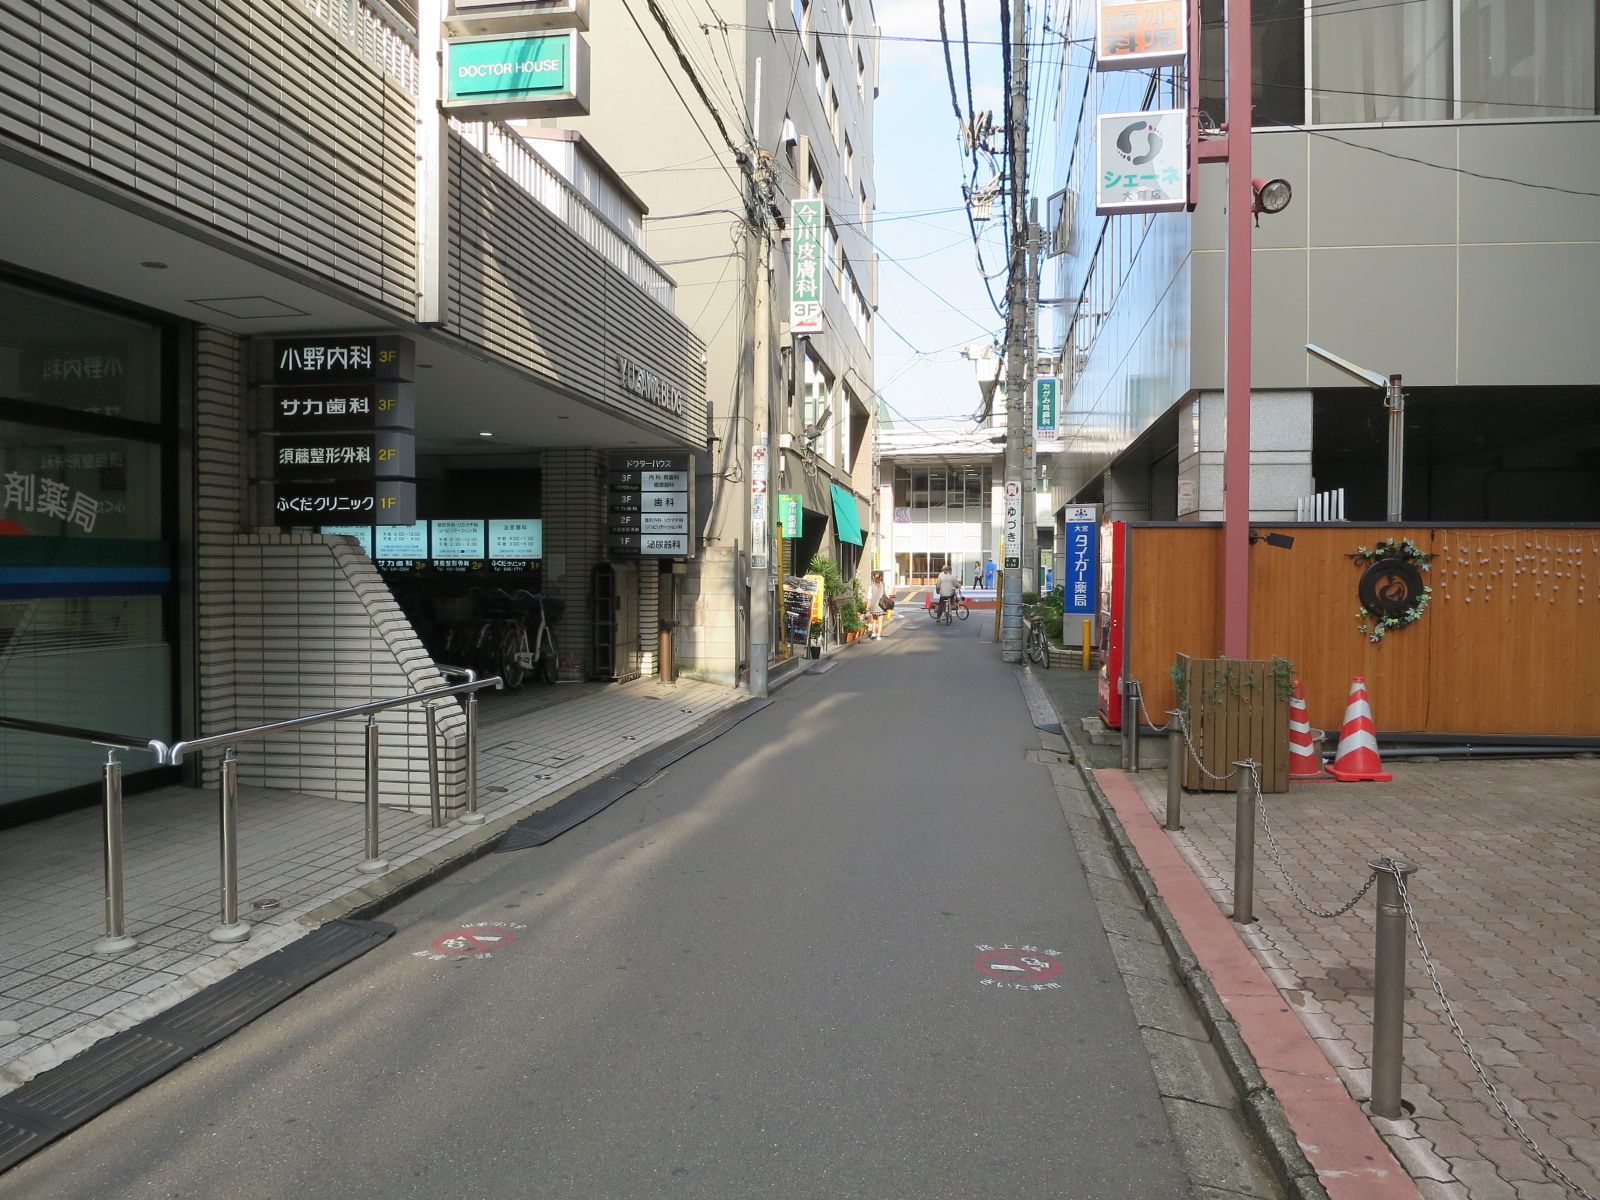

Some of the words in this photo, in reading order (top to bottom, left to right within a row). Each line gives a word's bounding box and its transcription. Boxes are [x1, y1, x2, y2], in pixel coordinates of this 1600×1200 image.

[458, 63, 512, 78] DOCTOR
[515, 59, 560, 73] HOUSE
[1104, 166, 1180, 189] シェーネ
[795, 203, 818, 299] 今川皮膚科
[794, 303, 818, 318] 3F
[280, 345, 372, 371] 小野内科
[378, 350, 398, 363] 3F
[280, 398, 370, 416] サカ歯科
[378, 398, 396, 411] 3F
[279, 447, 371, 465] 須藤整形外科
[378, 448, 397, 461] 2F
[626, 460, 672, 468] ドクターハウス
[621, 474, 632, 482] 3F
[3, 471, 98, 533] 剤薬局
[277, 496, 374, 512] ふくだクリニック
[380, 497, 397, 509] 1F
[621, 495, 632, 503] 3F
[653, 498, 675, 507] 歯科
[620, 516, 632, 524] 2F
[1007, 506, 1017, 542] ゆづき
[1074, 525, 1089, 533] 大宮
[620, 537, 631, 545] 1F
[646, 540, 681, 549] 泌尿器科
[415, 561, 427, 570] 3F
[472, 561, 483, 570] 2F
[530, 561, 541, 569] 1F
[1074, 534, 1090, 607] タイガー薬局
